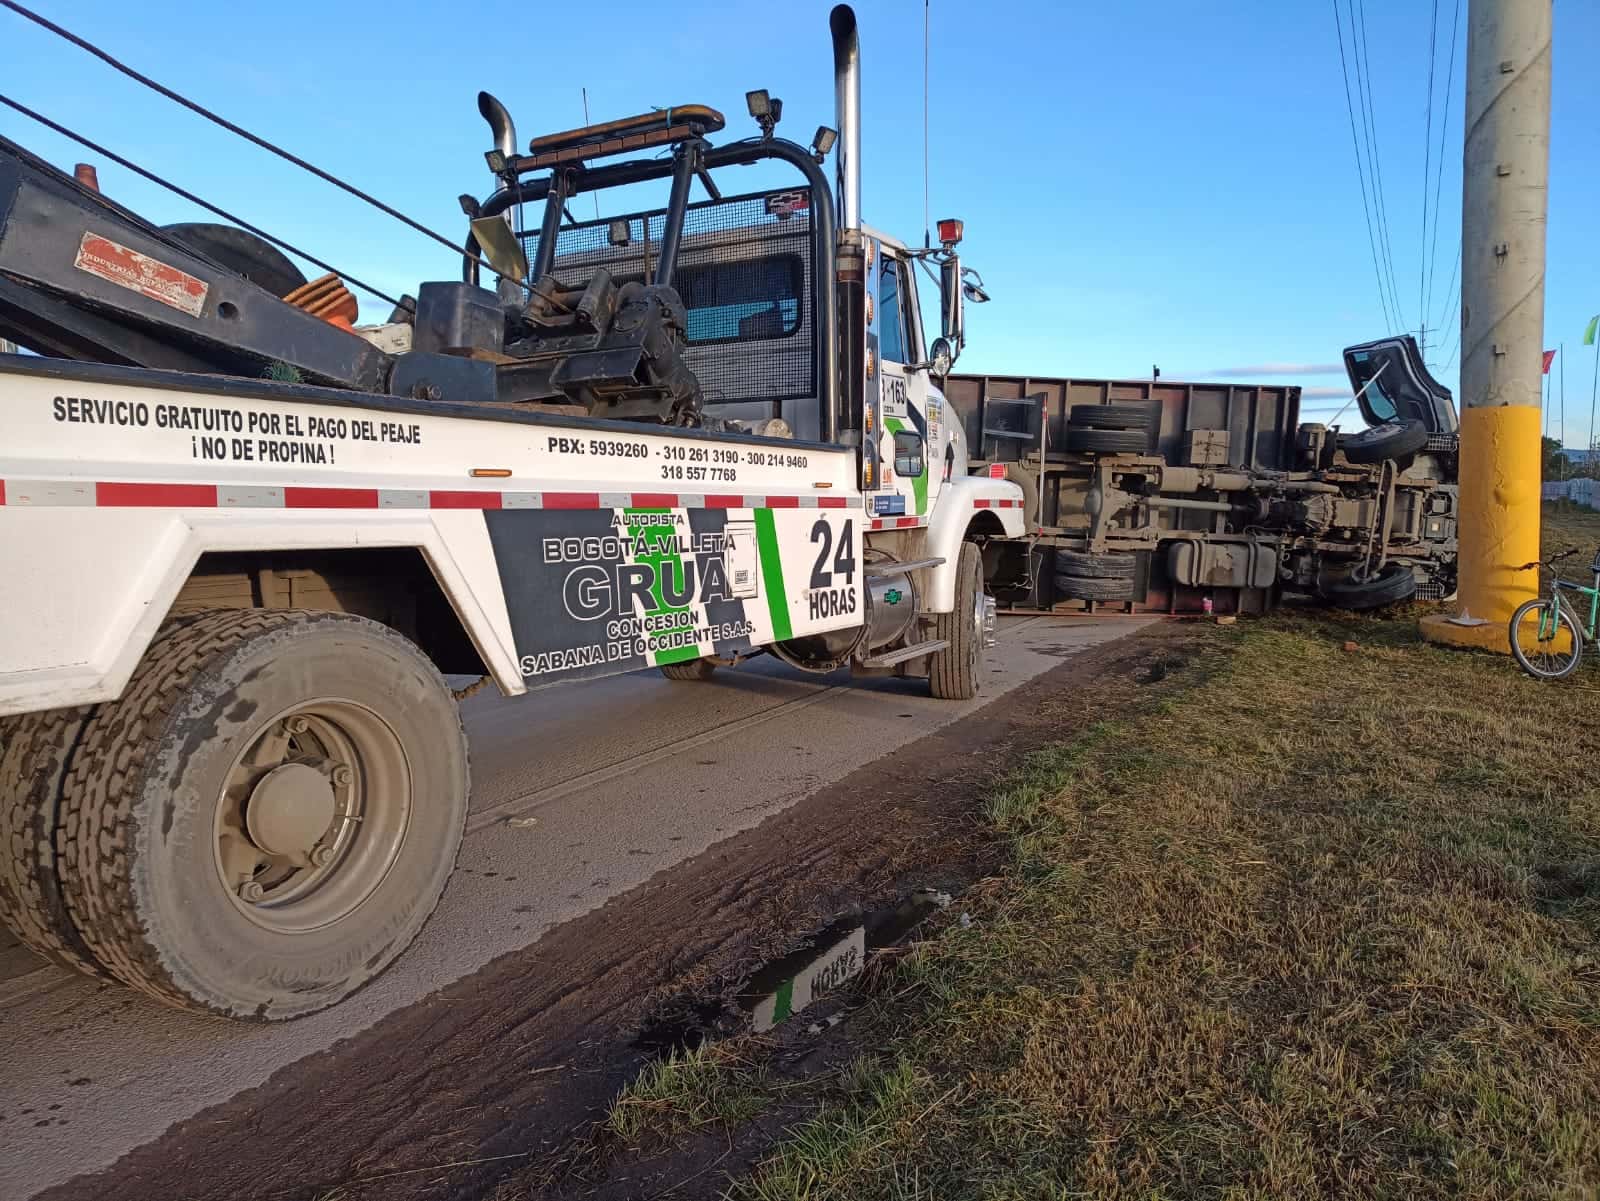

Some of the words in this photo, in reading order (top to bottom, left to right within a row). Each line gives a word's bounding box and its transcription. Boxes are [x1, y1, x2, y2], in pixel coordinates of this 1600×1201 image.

[53, 396, 149, 427] SERVICIO
[155, 403, 243, 433] GRATUITO
[248, 414, 282, 436] POR
[286, 415, 304, 437] EL
[308, 417, 347, 440] PAGO
[351, 420, 378, 442] DEL
[381, 422, 421, 445] PEAJE
[232, 438, 254, 462] DE
[547, 437, 585, 455] PBX:
[589, 440, 649, 459] 5939260
[663, 446, 686, 461] 310
[689, 447, 709, 462] 261
[712, 449, 739, 464] 3190
[747, 452, 765, 467] 300
[767, 454, 785, 468] 214
[787, 455, 808, 469] 9460
[661, 465, 684, 480] 318
[686, 466, 707, 481] 557
[710, 467, 737, 482] 7768
[610, 513, 685, 528] AUTOPISTA
[809, 518, 856, 590] 24
[562, 556, 735, 622] GRUA
[809, 586, 857, 621] HORAS
[606, 611, 700, 640] CONCESION
[520, 646, 603, 677] SABANA
[607, 640, 631, 660] DE
[634, 626, 721, 656] OCCIDENTE
[723, 621, 756, 640] S.A.S.
